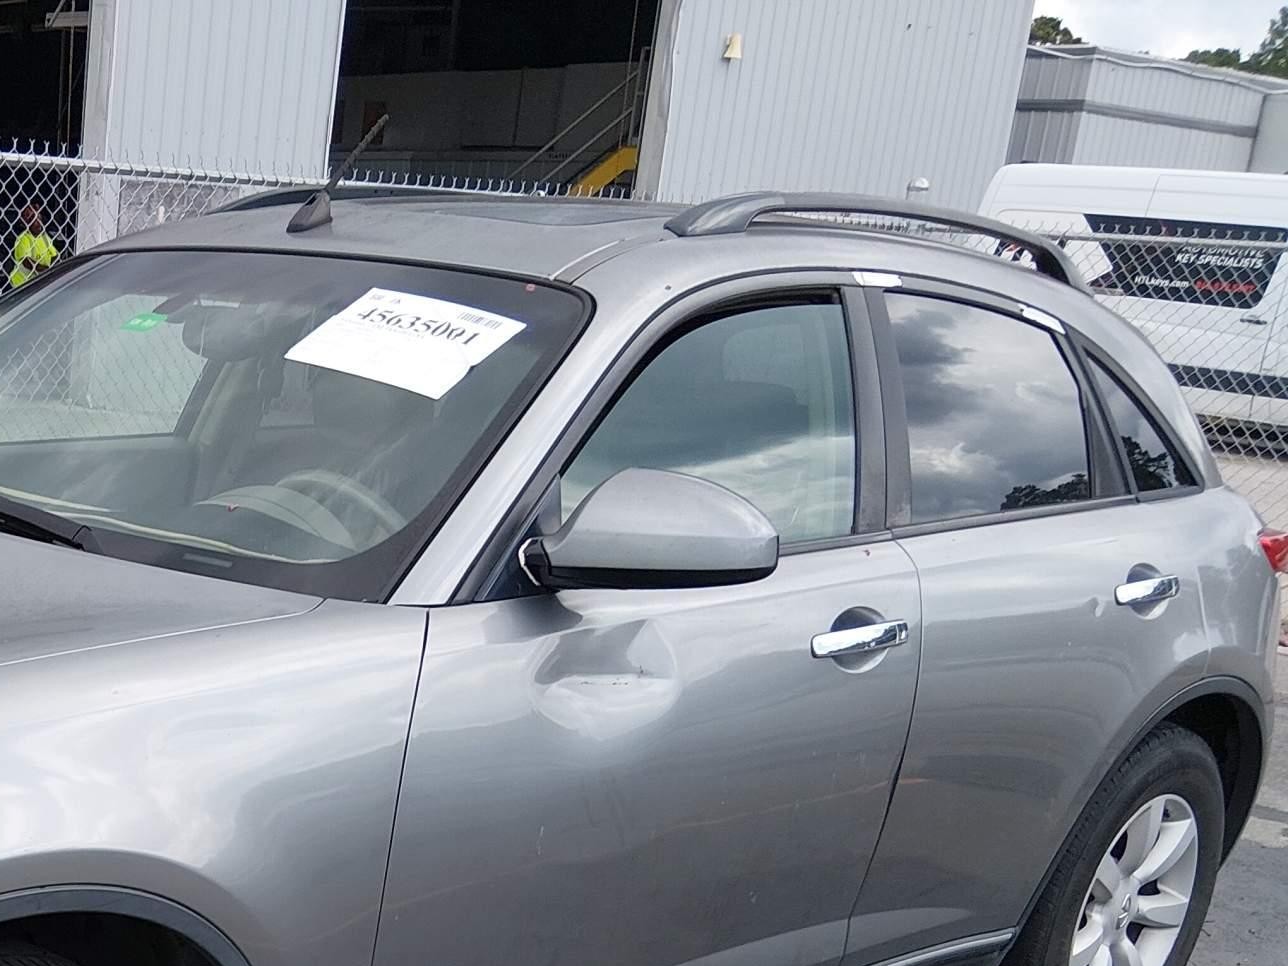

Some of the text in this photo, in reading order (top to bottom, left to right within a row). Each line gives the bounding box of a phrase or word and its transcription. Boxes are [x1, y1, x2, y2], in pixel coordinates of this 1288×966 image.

[1175, 253, 1264, 269] KEY SPECIALISTS
[357, 307, 480, 345] 45635001
